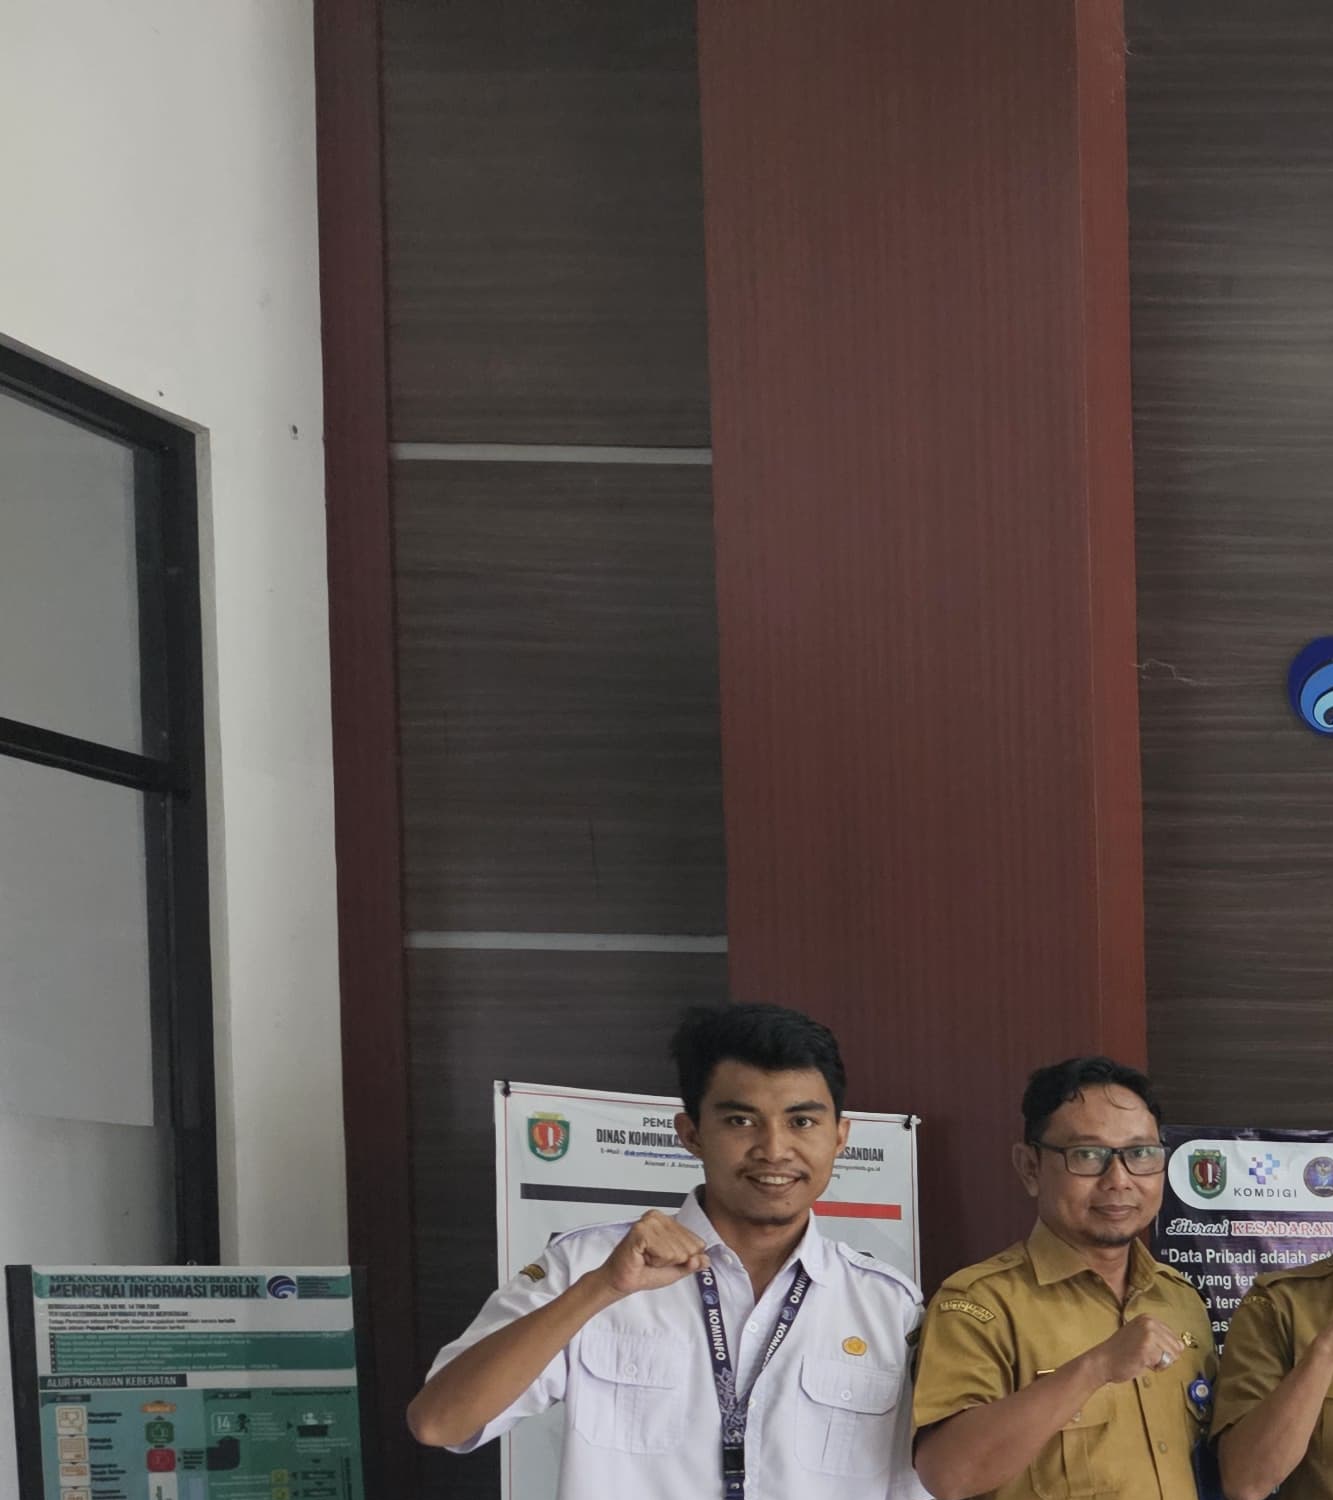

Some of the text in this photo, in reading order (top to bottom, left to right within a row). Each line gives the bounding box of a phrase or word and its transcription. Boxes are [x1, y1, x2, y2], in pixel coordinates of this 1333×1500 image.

[642, 1117, 673, 1129] PEME
[596, 1128, 885, 1162] DINAS KOMUNIKA SANDIAN
[1233, 1186, 1298, 1198] KOMDIGI
[1166, 1217, 1230, 1237] Literasi
[1206, 1248, 1257, 1264] Pribadi
[1260, 1249, 1307, 1265] adalah
[124, 1275, 190, 1284] PENGAJUAN
[193, 1275, 259, 1284] KEBERATAN
[789, 1271, 810, 1304] MINFO
[1197, 1272, 1258, 1290] yang ter
[49, 1283, 259, 1299] MENGENAI INFORMASI PUBLIK
[1215, 1295, 1242, 1309] ters
[707, 1309, 727, 1361] KOMINFO
[72, 1376, 124, 1387] PENGAJUAN
[125, 1375, 177, 1386] KEBERATAN
